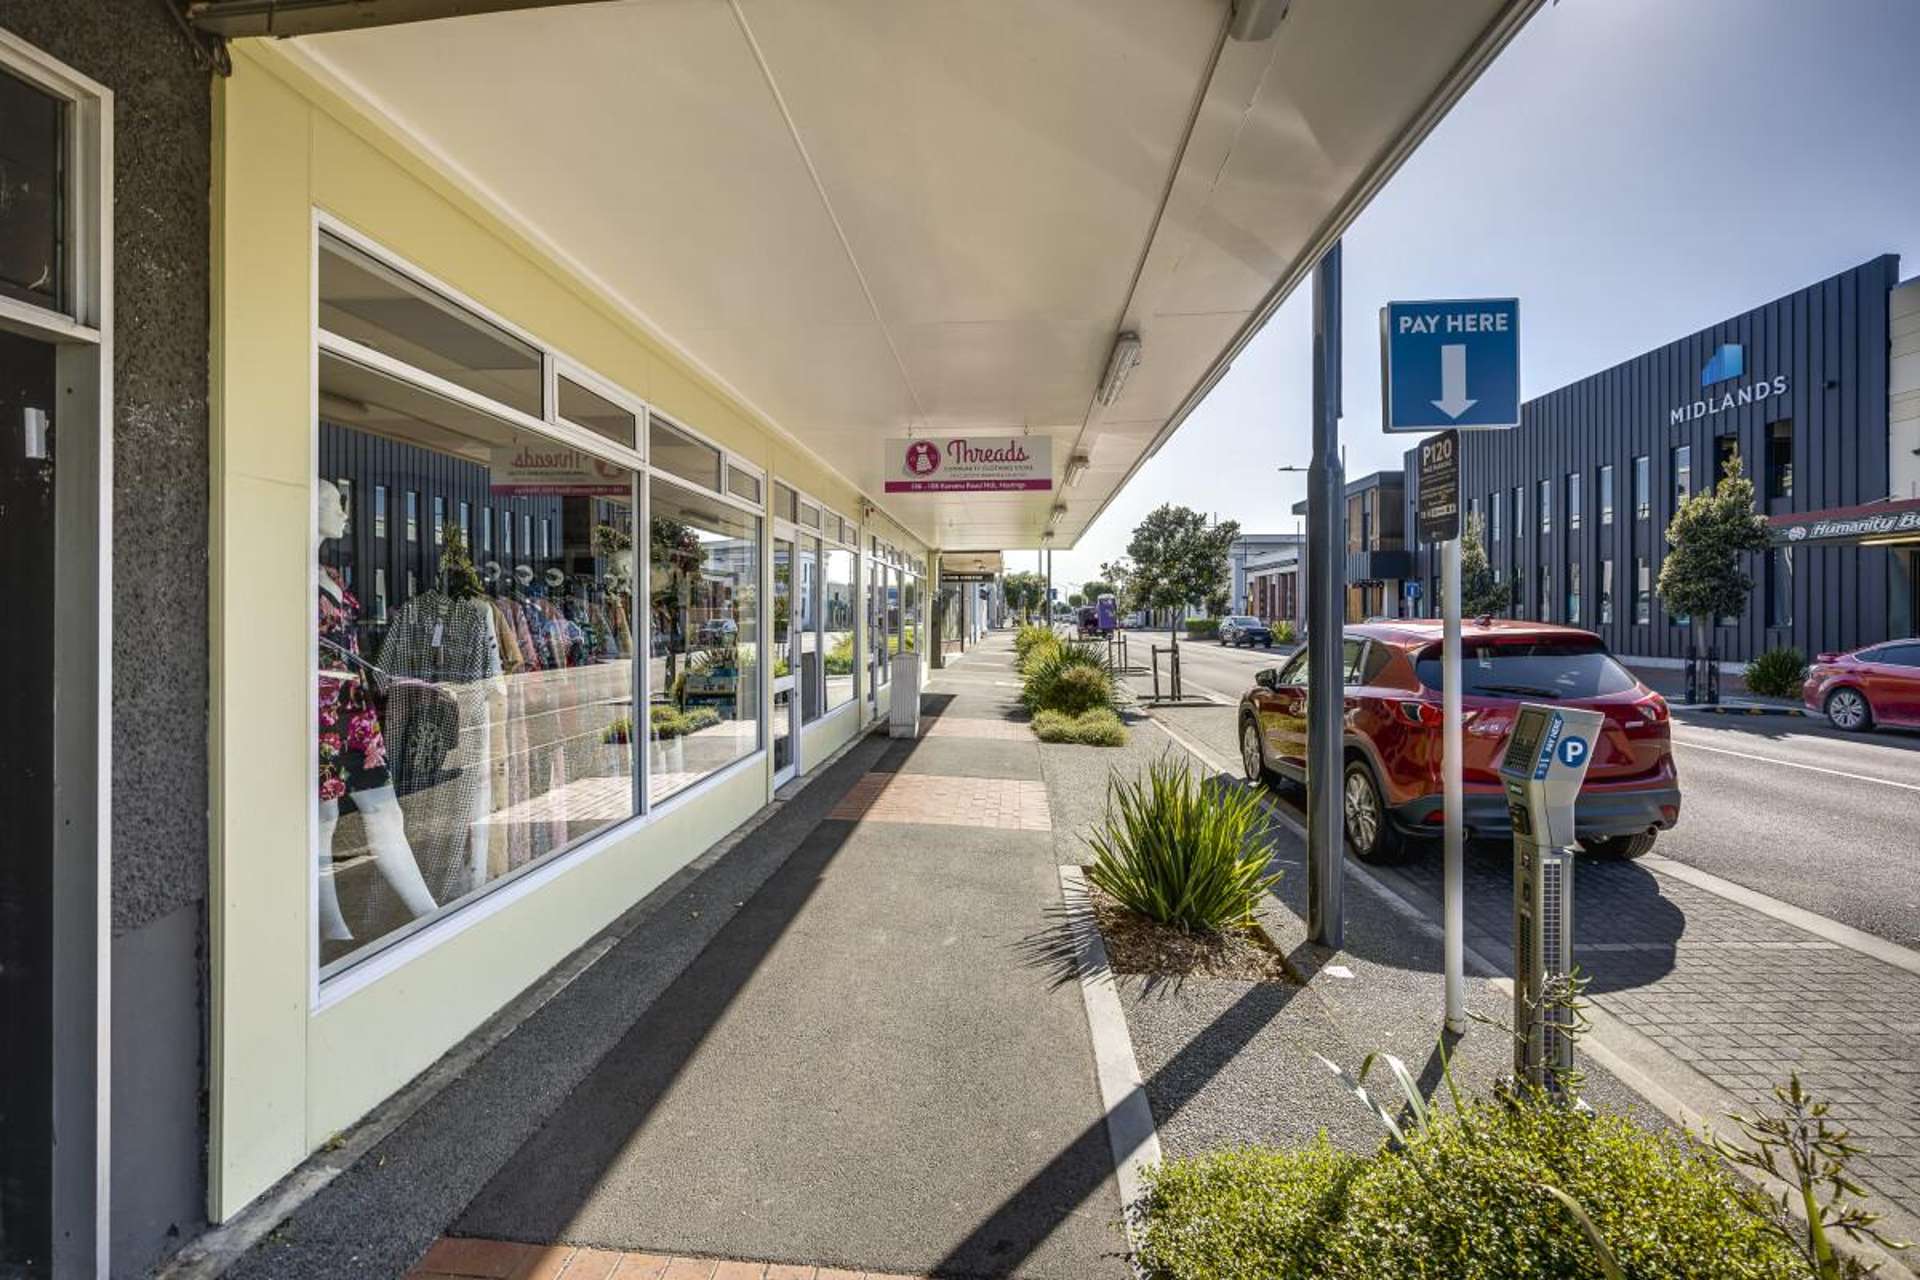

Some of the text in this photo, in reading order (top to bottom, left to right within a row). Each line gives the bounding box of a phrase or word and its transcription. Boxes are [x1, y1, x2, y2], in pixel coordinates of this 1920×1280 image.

[1399, 313, 1509, 334] PAY HERE
[1670, 375, 1788, 427] MIDLANDS
[947, 439, 1030, 464] Threads
[1423, 438, 1453, 467] P120
[1812, 516, 1897, 536] Humanity
